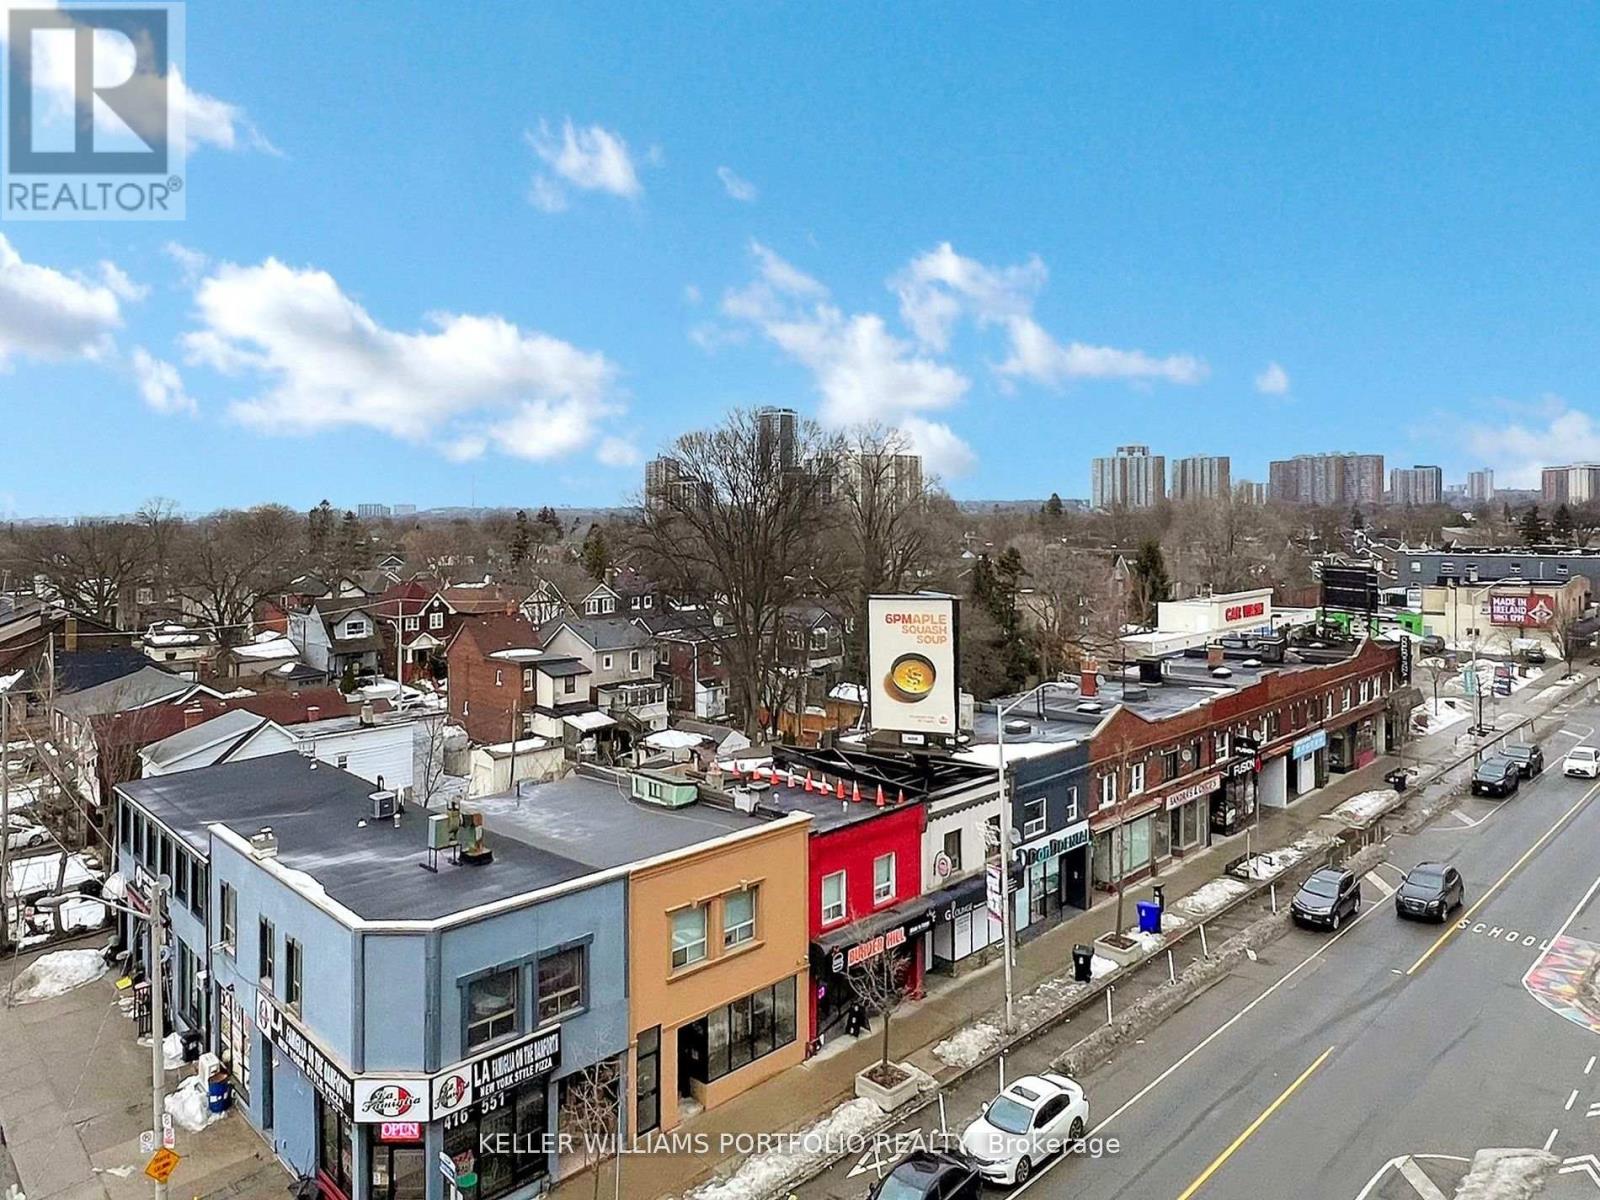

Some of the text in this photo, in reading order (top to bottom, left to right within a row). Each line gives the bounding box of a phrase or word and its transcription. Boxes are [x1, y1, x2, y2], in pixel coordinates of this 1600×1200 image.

[1493, 597, 1527, 607] MADE IN
[1493, 605, 1527, 615] IRELAND
[885, 613, 947, 625] 6PMAPLE
[901, 625, 947, 635] SQUASH
[916, 635, 947, 645] SOUP
[1233, 758, 1255, 777] FUSION
[1457, 919, 1550, 951] SCHOOL
[474, 1060, 491, 1088] LA
[480, 1056, 553, 1098] NEW YORK STYLE PIZZA
[361, 1095, 421, 1112] Famiglia
[382, 1123, 418, 1137] OPEN
